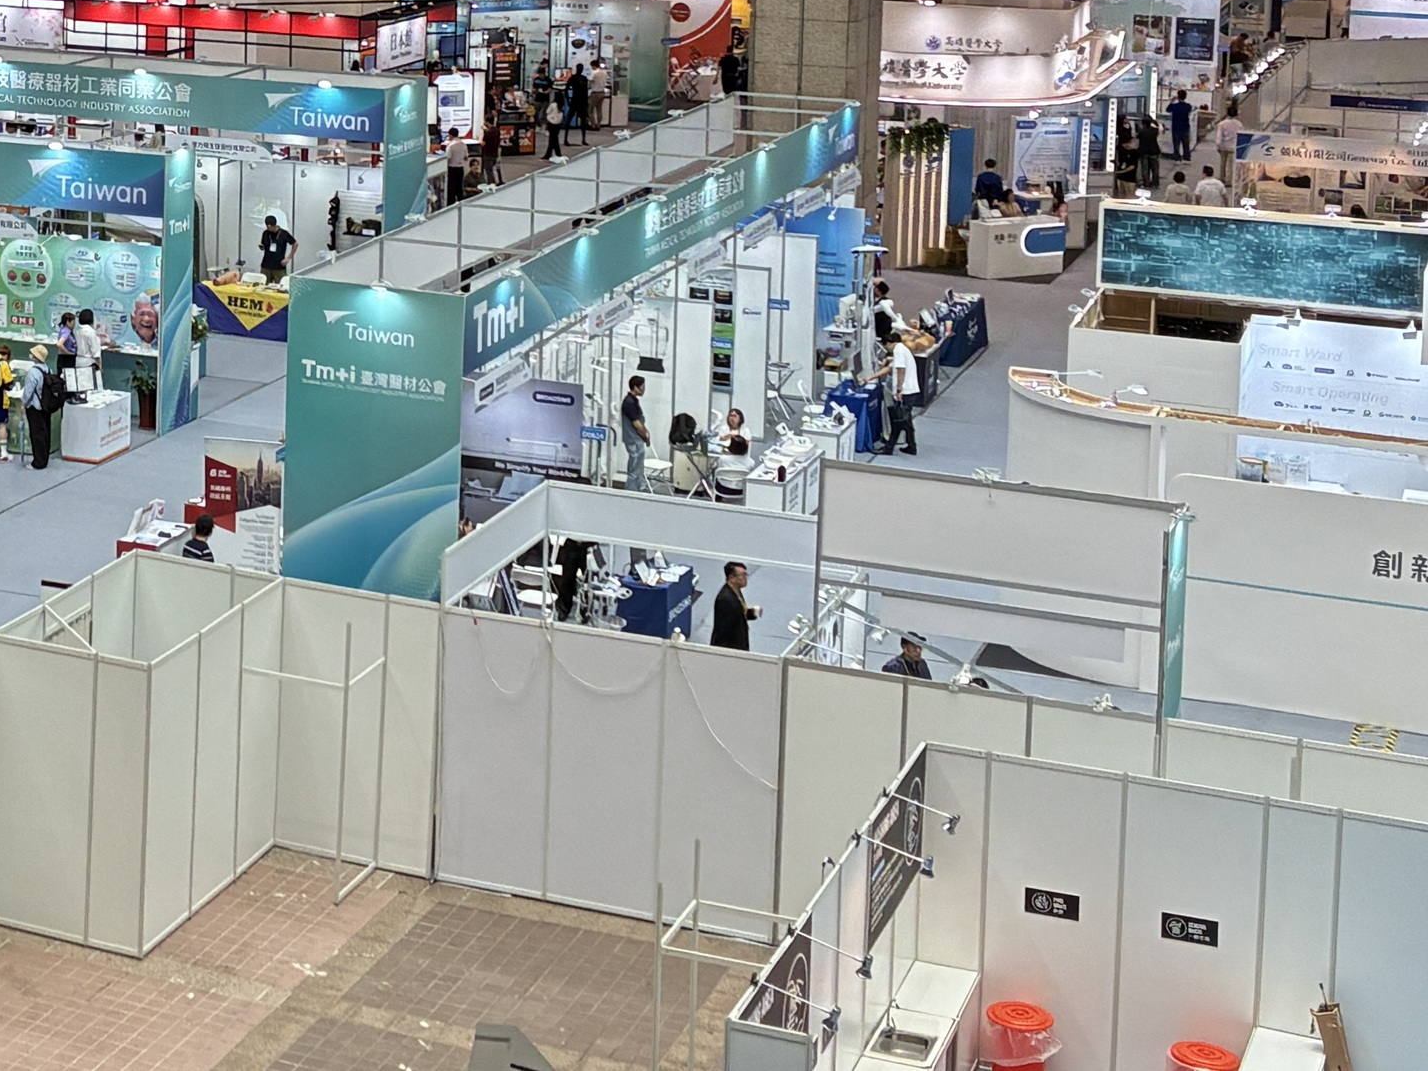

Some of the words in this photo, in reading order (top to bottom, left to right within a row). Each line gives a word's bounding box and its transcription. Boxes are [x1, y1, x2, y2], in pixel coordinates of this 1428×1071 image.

[17, 96, 78, 109] TECHNOLOGY
[80, 100, 125, 113] INDUSTRY
[289, 107, 370, 132] Taiwan
[56, 174, 147, 205] Taiwan
[227, 296, 264, 311] HEM
[344, 322, 415, 348] Taiwan
[1258, 343, 1300, 359] Smart
[1304, 347, 1343, 362] Ward
[1271, 381, 1314, 393] Smart
[1318, 386, 1389, 406] Operating
